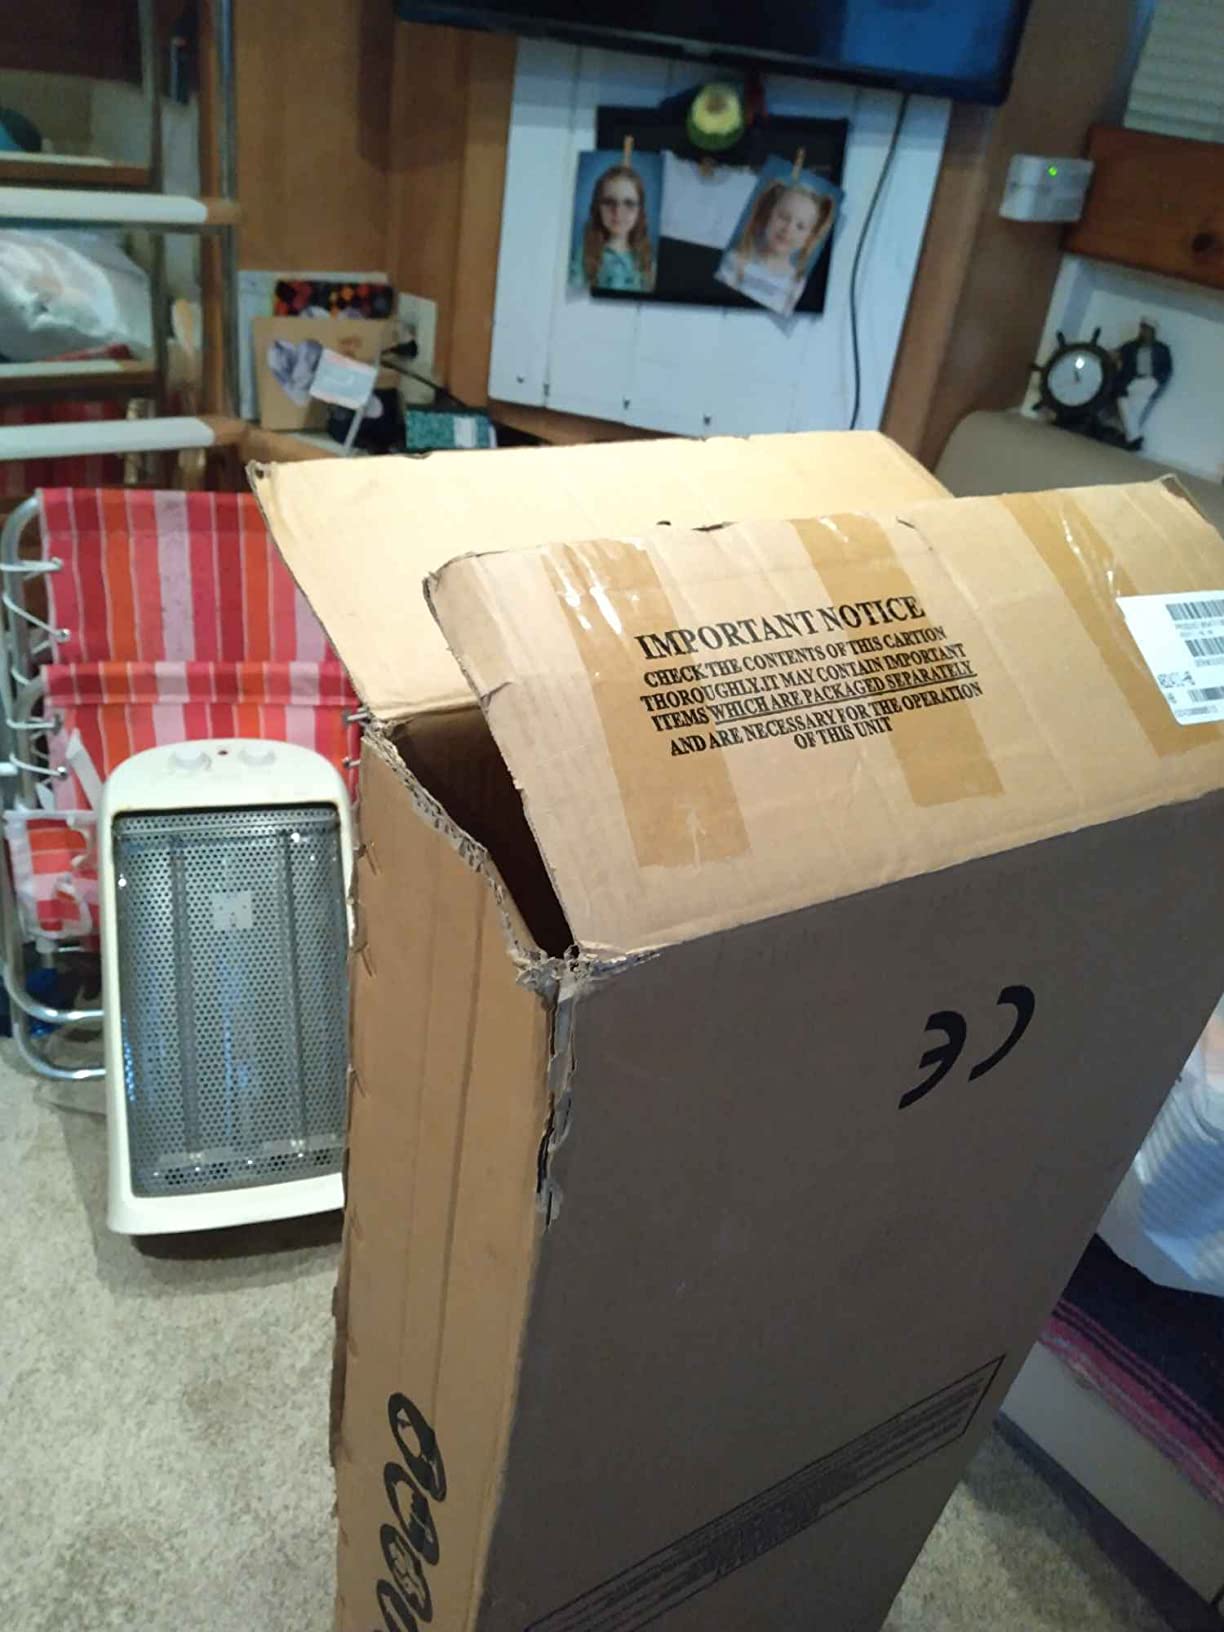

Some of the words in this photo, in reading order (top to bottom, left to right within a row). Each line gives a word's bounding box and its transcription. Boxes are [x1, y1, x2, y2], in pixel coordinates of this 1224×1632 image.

[634, 610, 818, 659] IMPORTANT
[816, 595, 926, 632] NOTICE
[643, 662, 708, 688] CHECK
[705, 658, 742, 678] THE
[742, 645, 826, 672] CONTENTS
[825, 641, 848, 659] OF
[846, 635, 884, 655] THIS
[780, 667, 815, 688] MAY
[816, 655, 885, 682] CONTAIN
[884, 643, 967, 670] IMPORTANT
[651, 706, 710, 731] ITEMS
[706, 696, 770, 721] WHICH
[771, 689, 803, 710] ARE
[802, 676, 885, 705] PACKAGED
[885, 661, 975, 689] SEPARATELY
[671, 735, 706, 756] AND
[709, 728, 743, 749] ARE
[742, 708, 838, 741] NECESSARY
[837, 703, 871, 725] FOR
[868, 697, 903, 717] THE
[901, 682, 983, 711] OPERATION
[794, 733, 816, 749] OF
[815, 724, 854, 746] THIS
[853, 716, 893, 737] UNIT
